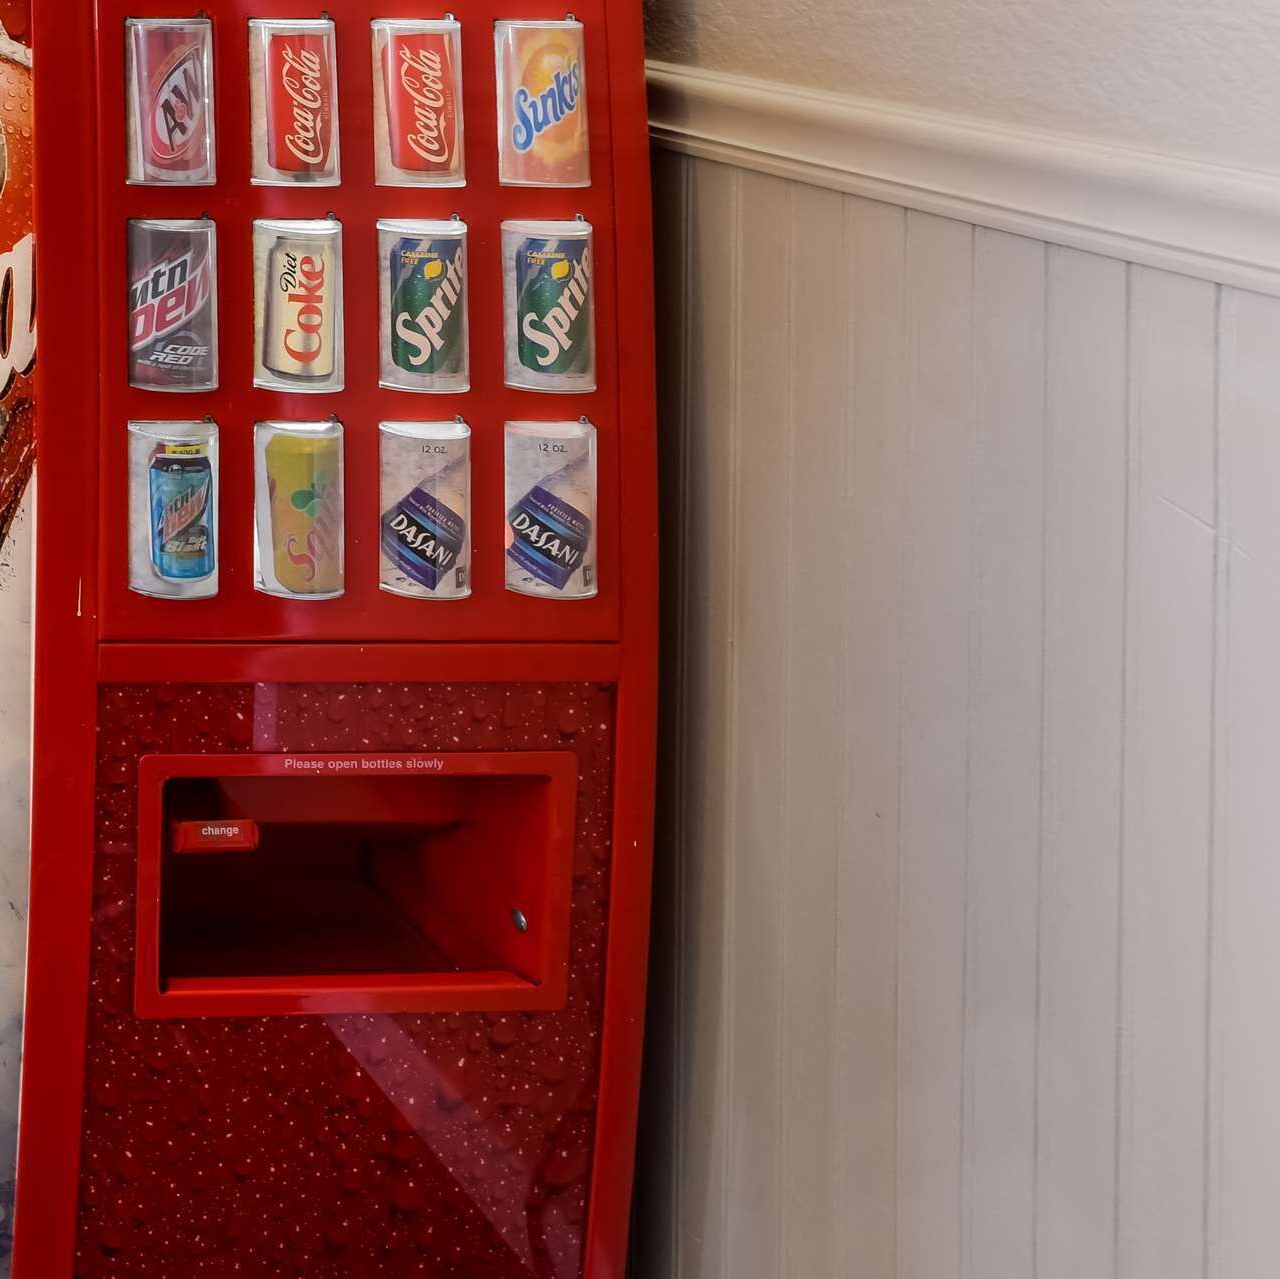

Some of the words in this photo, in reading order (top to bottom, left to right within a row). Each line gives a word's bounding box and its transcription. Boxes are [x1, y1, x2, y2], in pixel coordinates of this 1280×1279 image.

[160, 46, 203, 152] A&W
[282, 43, 324, 163] Coca-Cola
[399, 43, 449, 163] Coca-Cola
[513, 62, 580, 151] Sunkis
[279, 252, 298, 293] Diet
[401, 257, 418, 265] FREE
[284, 255, 325, 363] Coke
[395, 247, 462, 366] Sprite
[522, 247, 590, 367] Sprite
[149, 351, 193, 365] RED
[163, 344, 209, 356] CODE
[421, 445, 431, 454] 12
[538, 443, 549, 452] 12
[390, 513, 453, 566] DASANI
[512, 513, 579, 565] DASANI
[284, 758, 324, 769] Please
[327, 760, 358, 771] open
[362, 758, 402, 769] bottles
[406, 758, 444, 771] slowly
[201, 826, 239, 837] change
